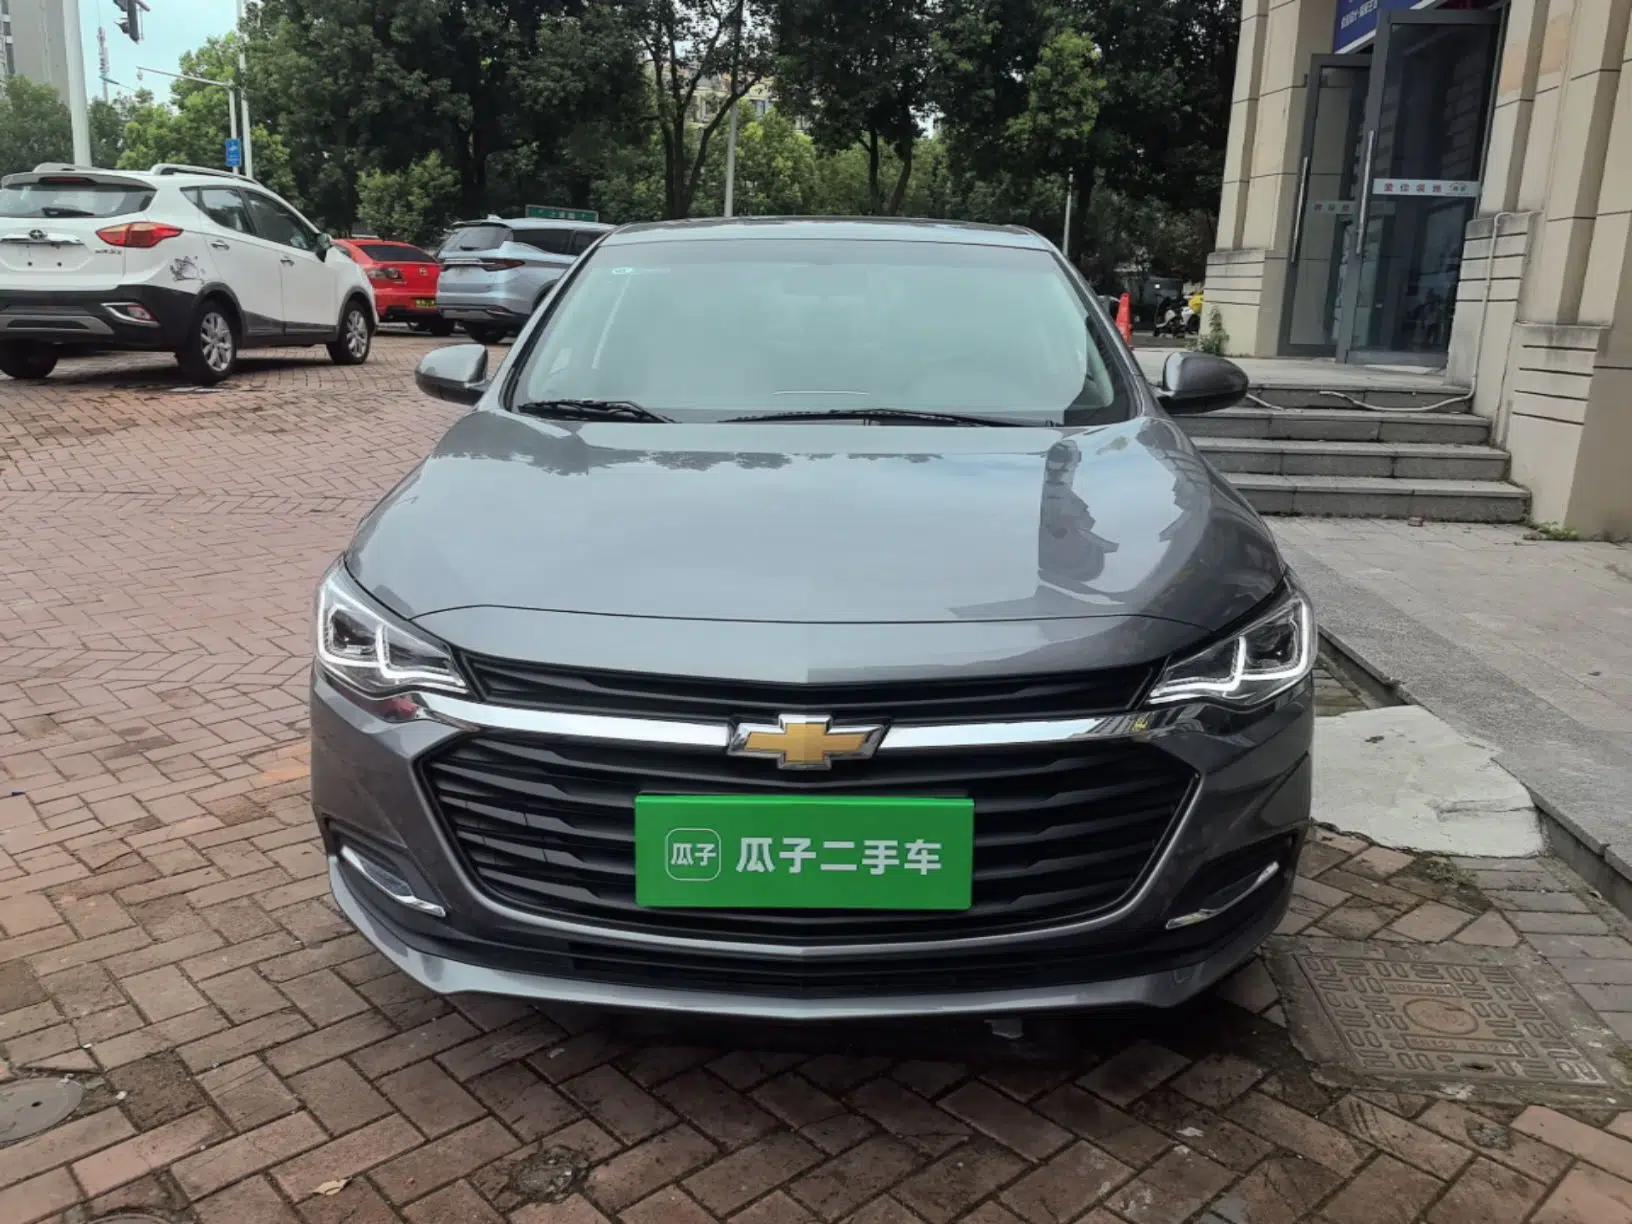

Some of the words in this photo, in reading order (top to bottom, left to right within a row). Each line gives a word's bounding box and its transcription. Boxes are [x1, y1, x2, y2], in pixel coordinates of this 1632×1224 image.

[670, 843, 717, 865] 瓜子
[735, 837, 942, 875] 瓜子二手车
